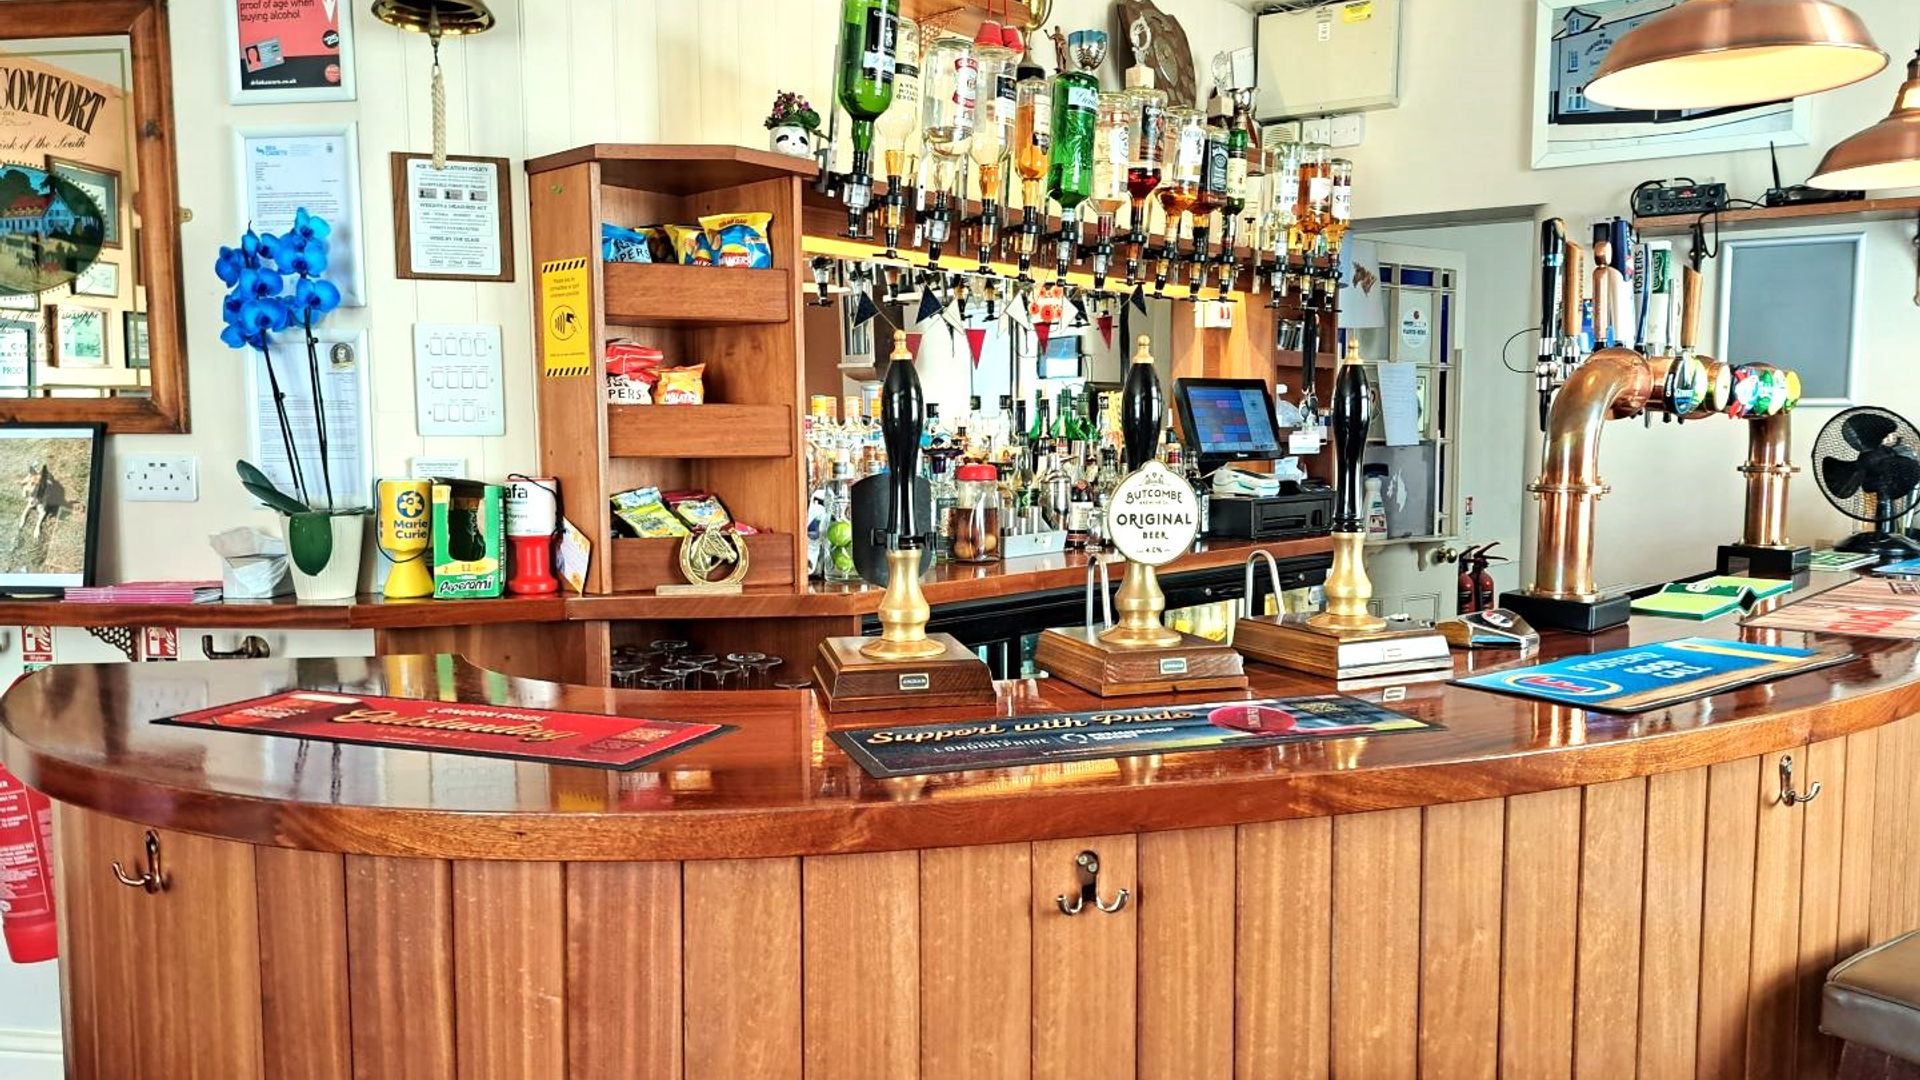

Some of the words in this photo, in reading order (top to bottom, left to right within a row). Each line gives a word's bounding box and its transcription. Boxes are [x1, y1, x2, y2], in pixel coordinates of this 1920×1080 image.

[240, 0, 262, 10] proof
[263, 0, 271, 8] of
[273, 0, 288, 10] age
[240, 11, 268, 22] buying
[270, 9, 300, 21] alcohol
[35, 136, 50, 149] the
[1125, 488, 1183, 505] BUTCOMBE
[393, 518, 428, 530] Marie
[1116, 513, 1192, 529] ORIGINAL
[394, 529, 428, 541] Curie
[1142, 530, 1169, 540] BEER
[439, 575, 493, 595] Peperami
[866, 723, 1005, 744] Support
[1014, 717, 1088, 732] with
[1090, 709, 1193, 725] Pride
